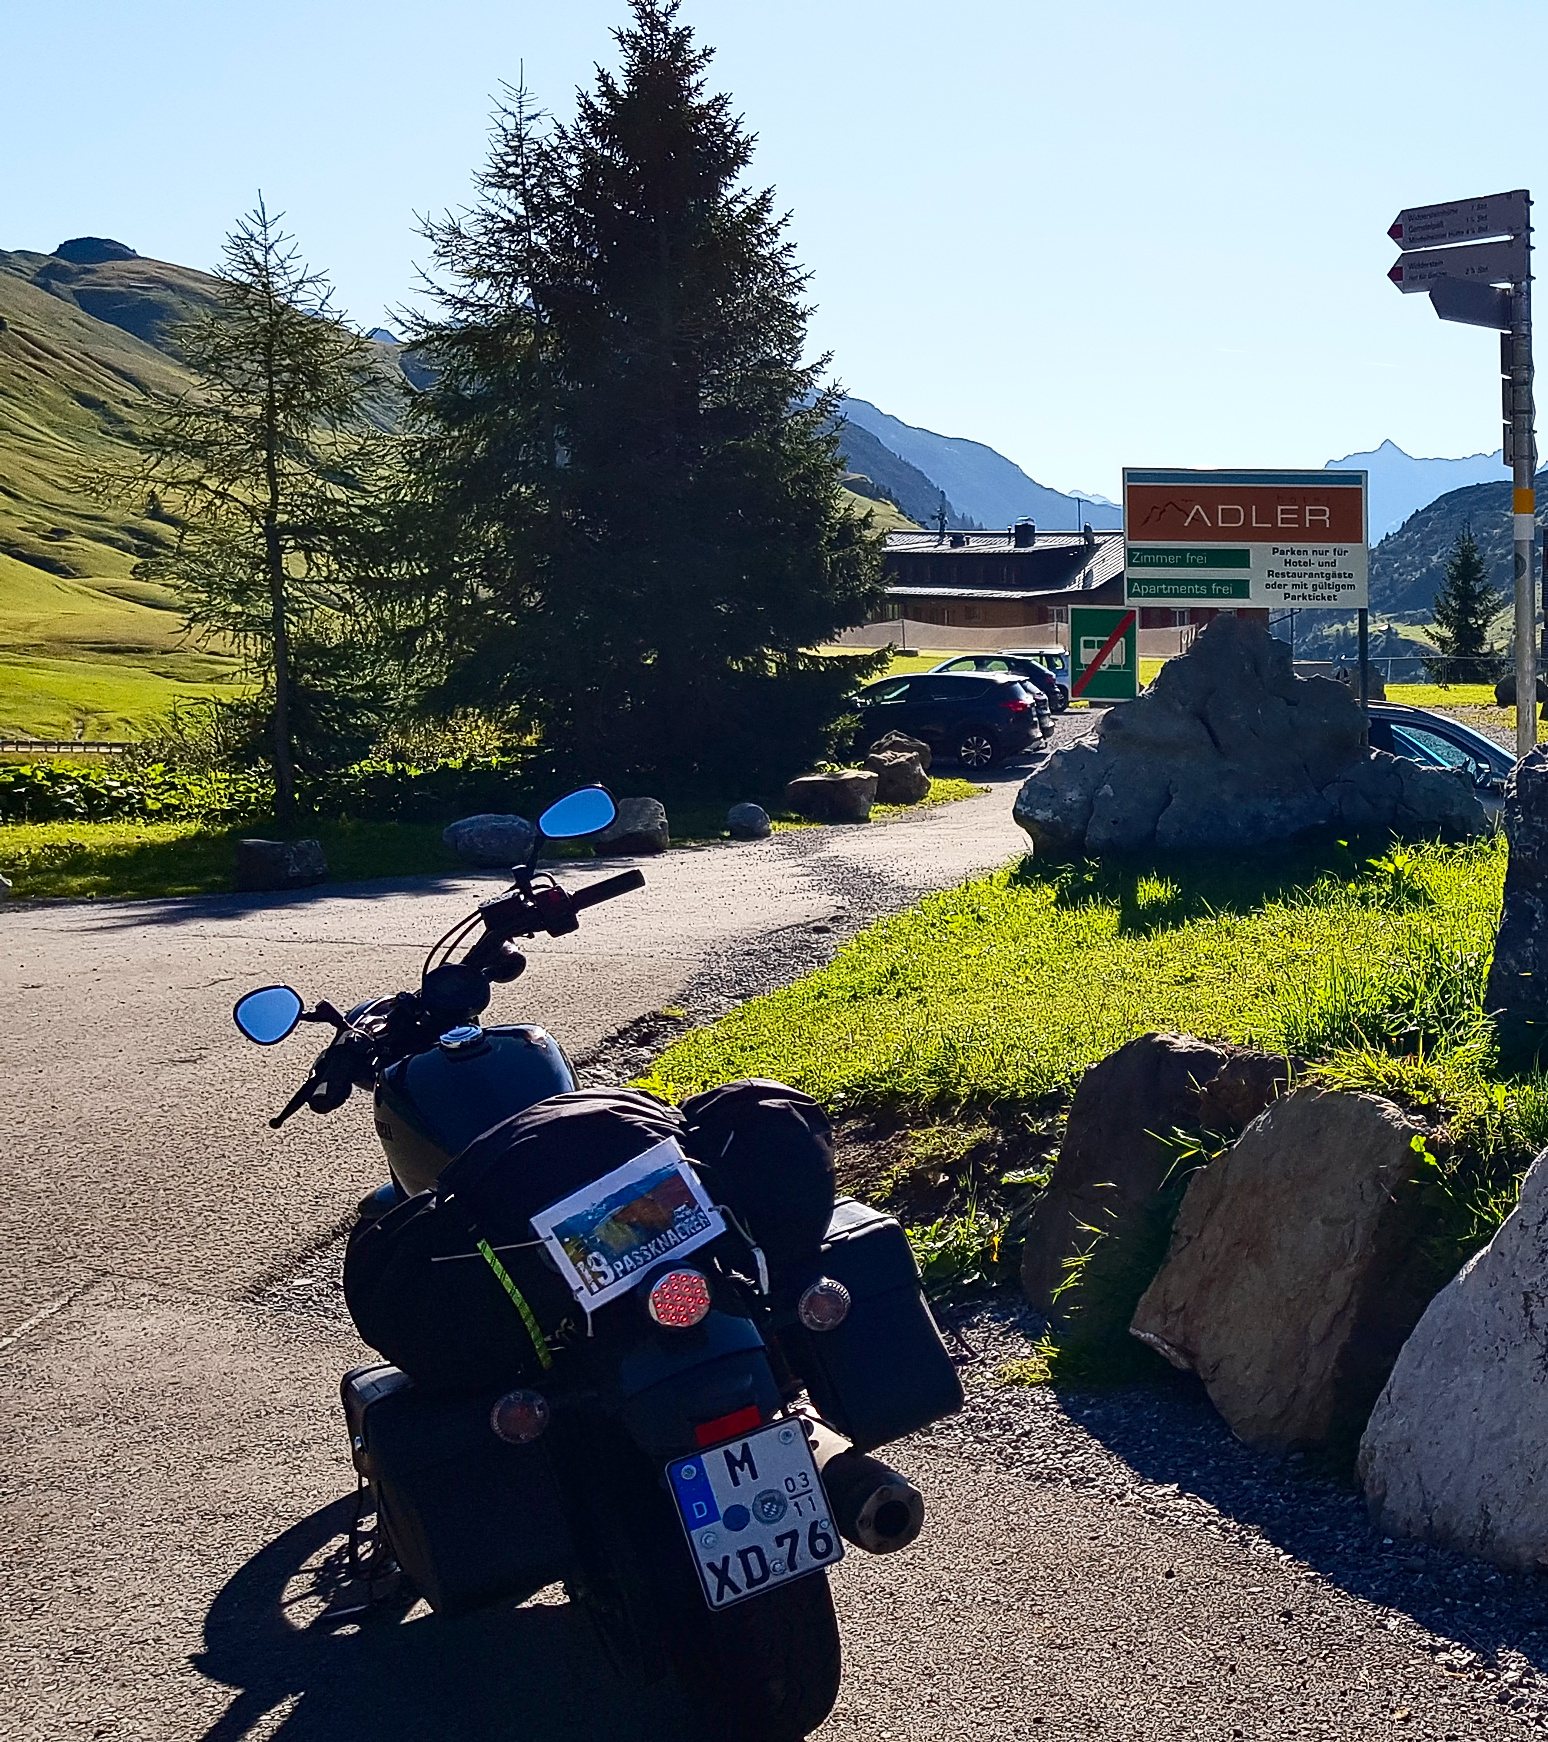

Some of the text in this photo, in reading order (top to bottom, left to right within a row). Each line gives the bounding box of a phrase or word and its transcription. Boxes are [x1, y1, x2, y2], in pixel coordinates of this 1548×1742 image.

[1184, 504, 1330, 528] ADLER
[1132, 551, 1207, 564] Zimmer frei
[1271, 547, 1349, 557] Parken nur für
[1283, 559, 1337, 568] Hotel- und
[1267, 570, 1354, 581] Restaurantgäste
[1131, 582, 1233, 597] Apartments frei
[1264, 581, 1356, 593] oder mit gültigem
[1283, 592, 1338, 602] Parkticket
[613, 1210, 710, 1278] PASSKNACKER
[723, 1442, 759, 1488] M
[784, 1471, 810, 1494] 03
[692, 1500, 708, 1519] D
[793, 1495, 817, 1517] 11
[706, 1519, 834, 1602] XD 76
